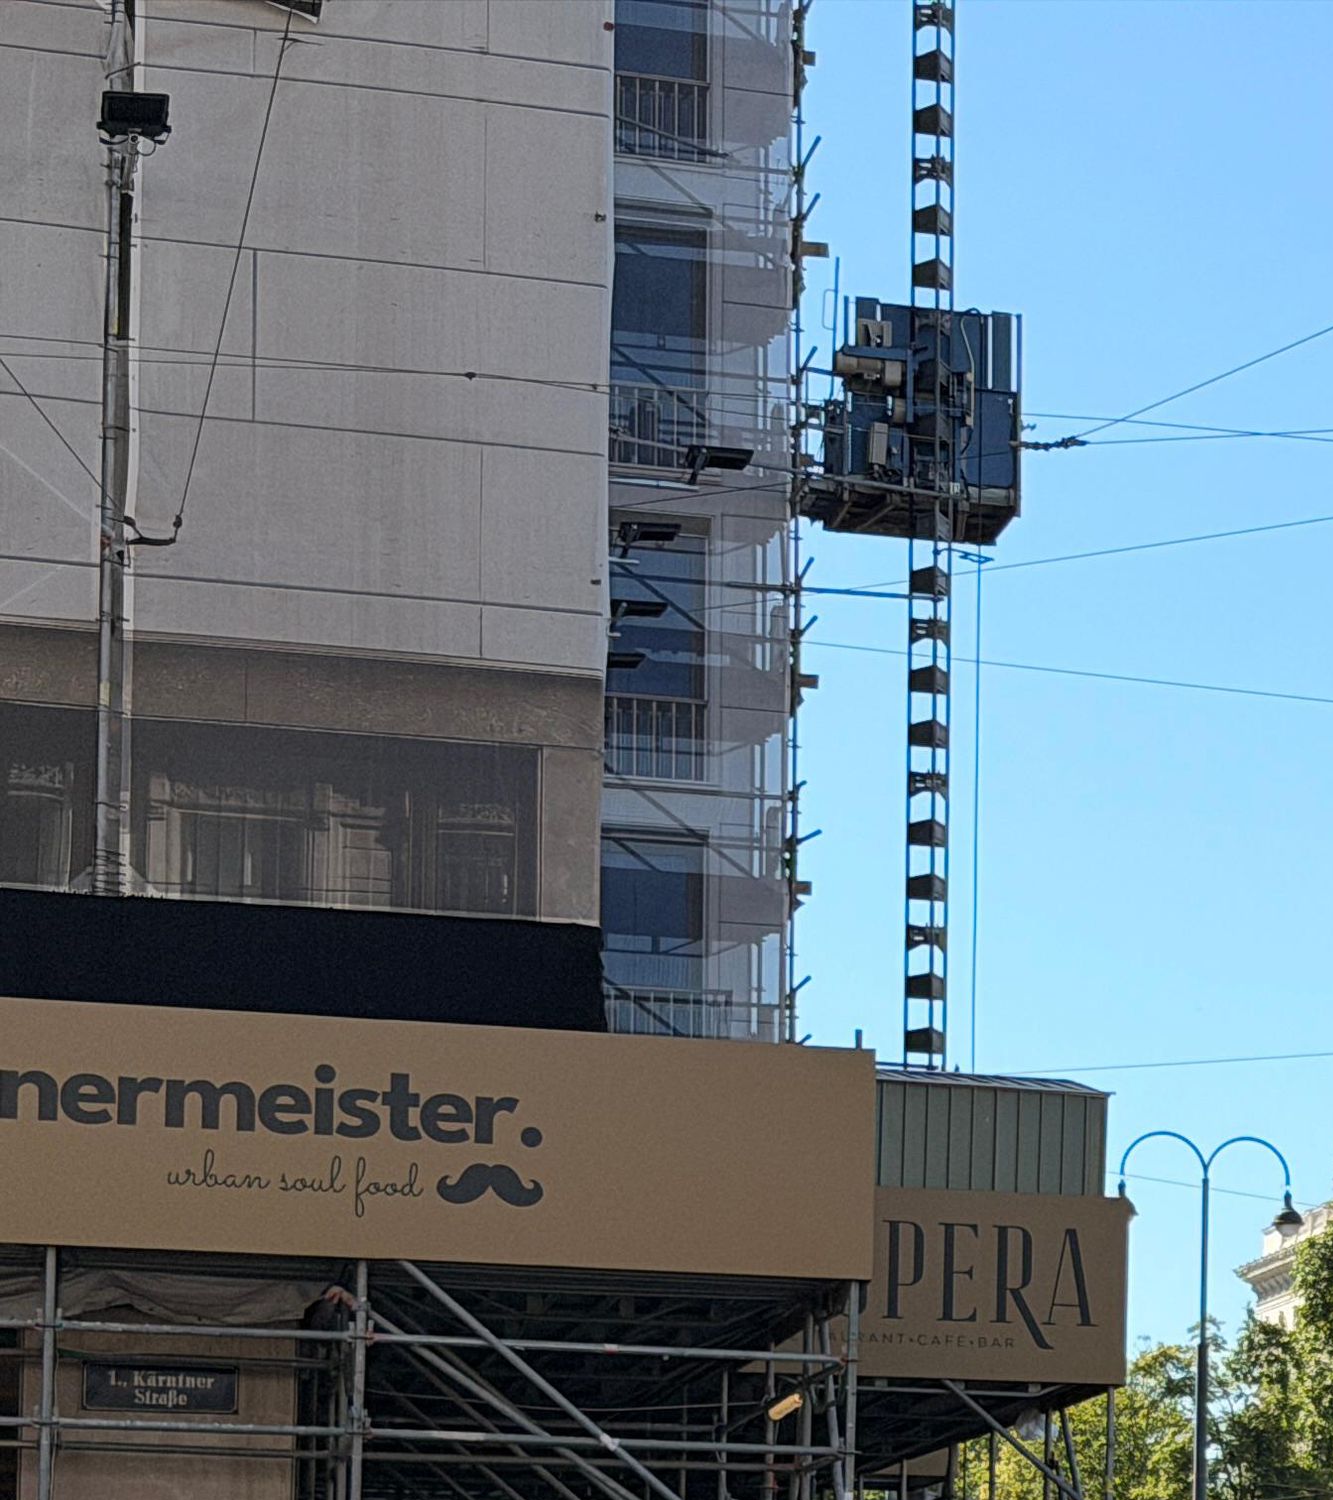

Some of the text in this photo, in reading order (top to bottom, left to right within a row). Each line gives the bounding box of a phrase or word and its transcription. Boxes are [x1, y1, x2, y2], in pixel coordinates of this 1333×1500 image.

[167, 1149, 424, 1218] urban soul food
[858, 1219, 1098, 1350] PERA
[978, 1335, 1016, 1349] BAR
[133, 1370, 215, 1390] Kärntner
[134, 1388, 188, 1409] Straße
